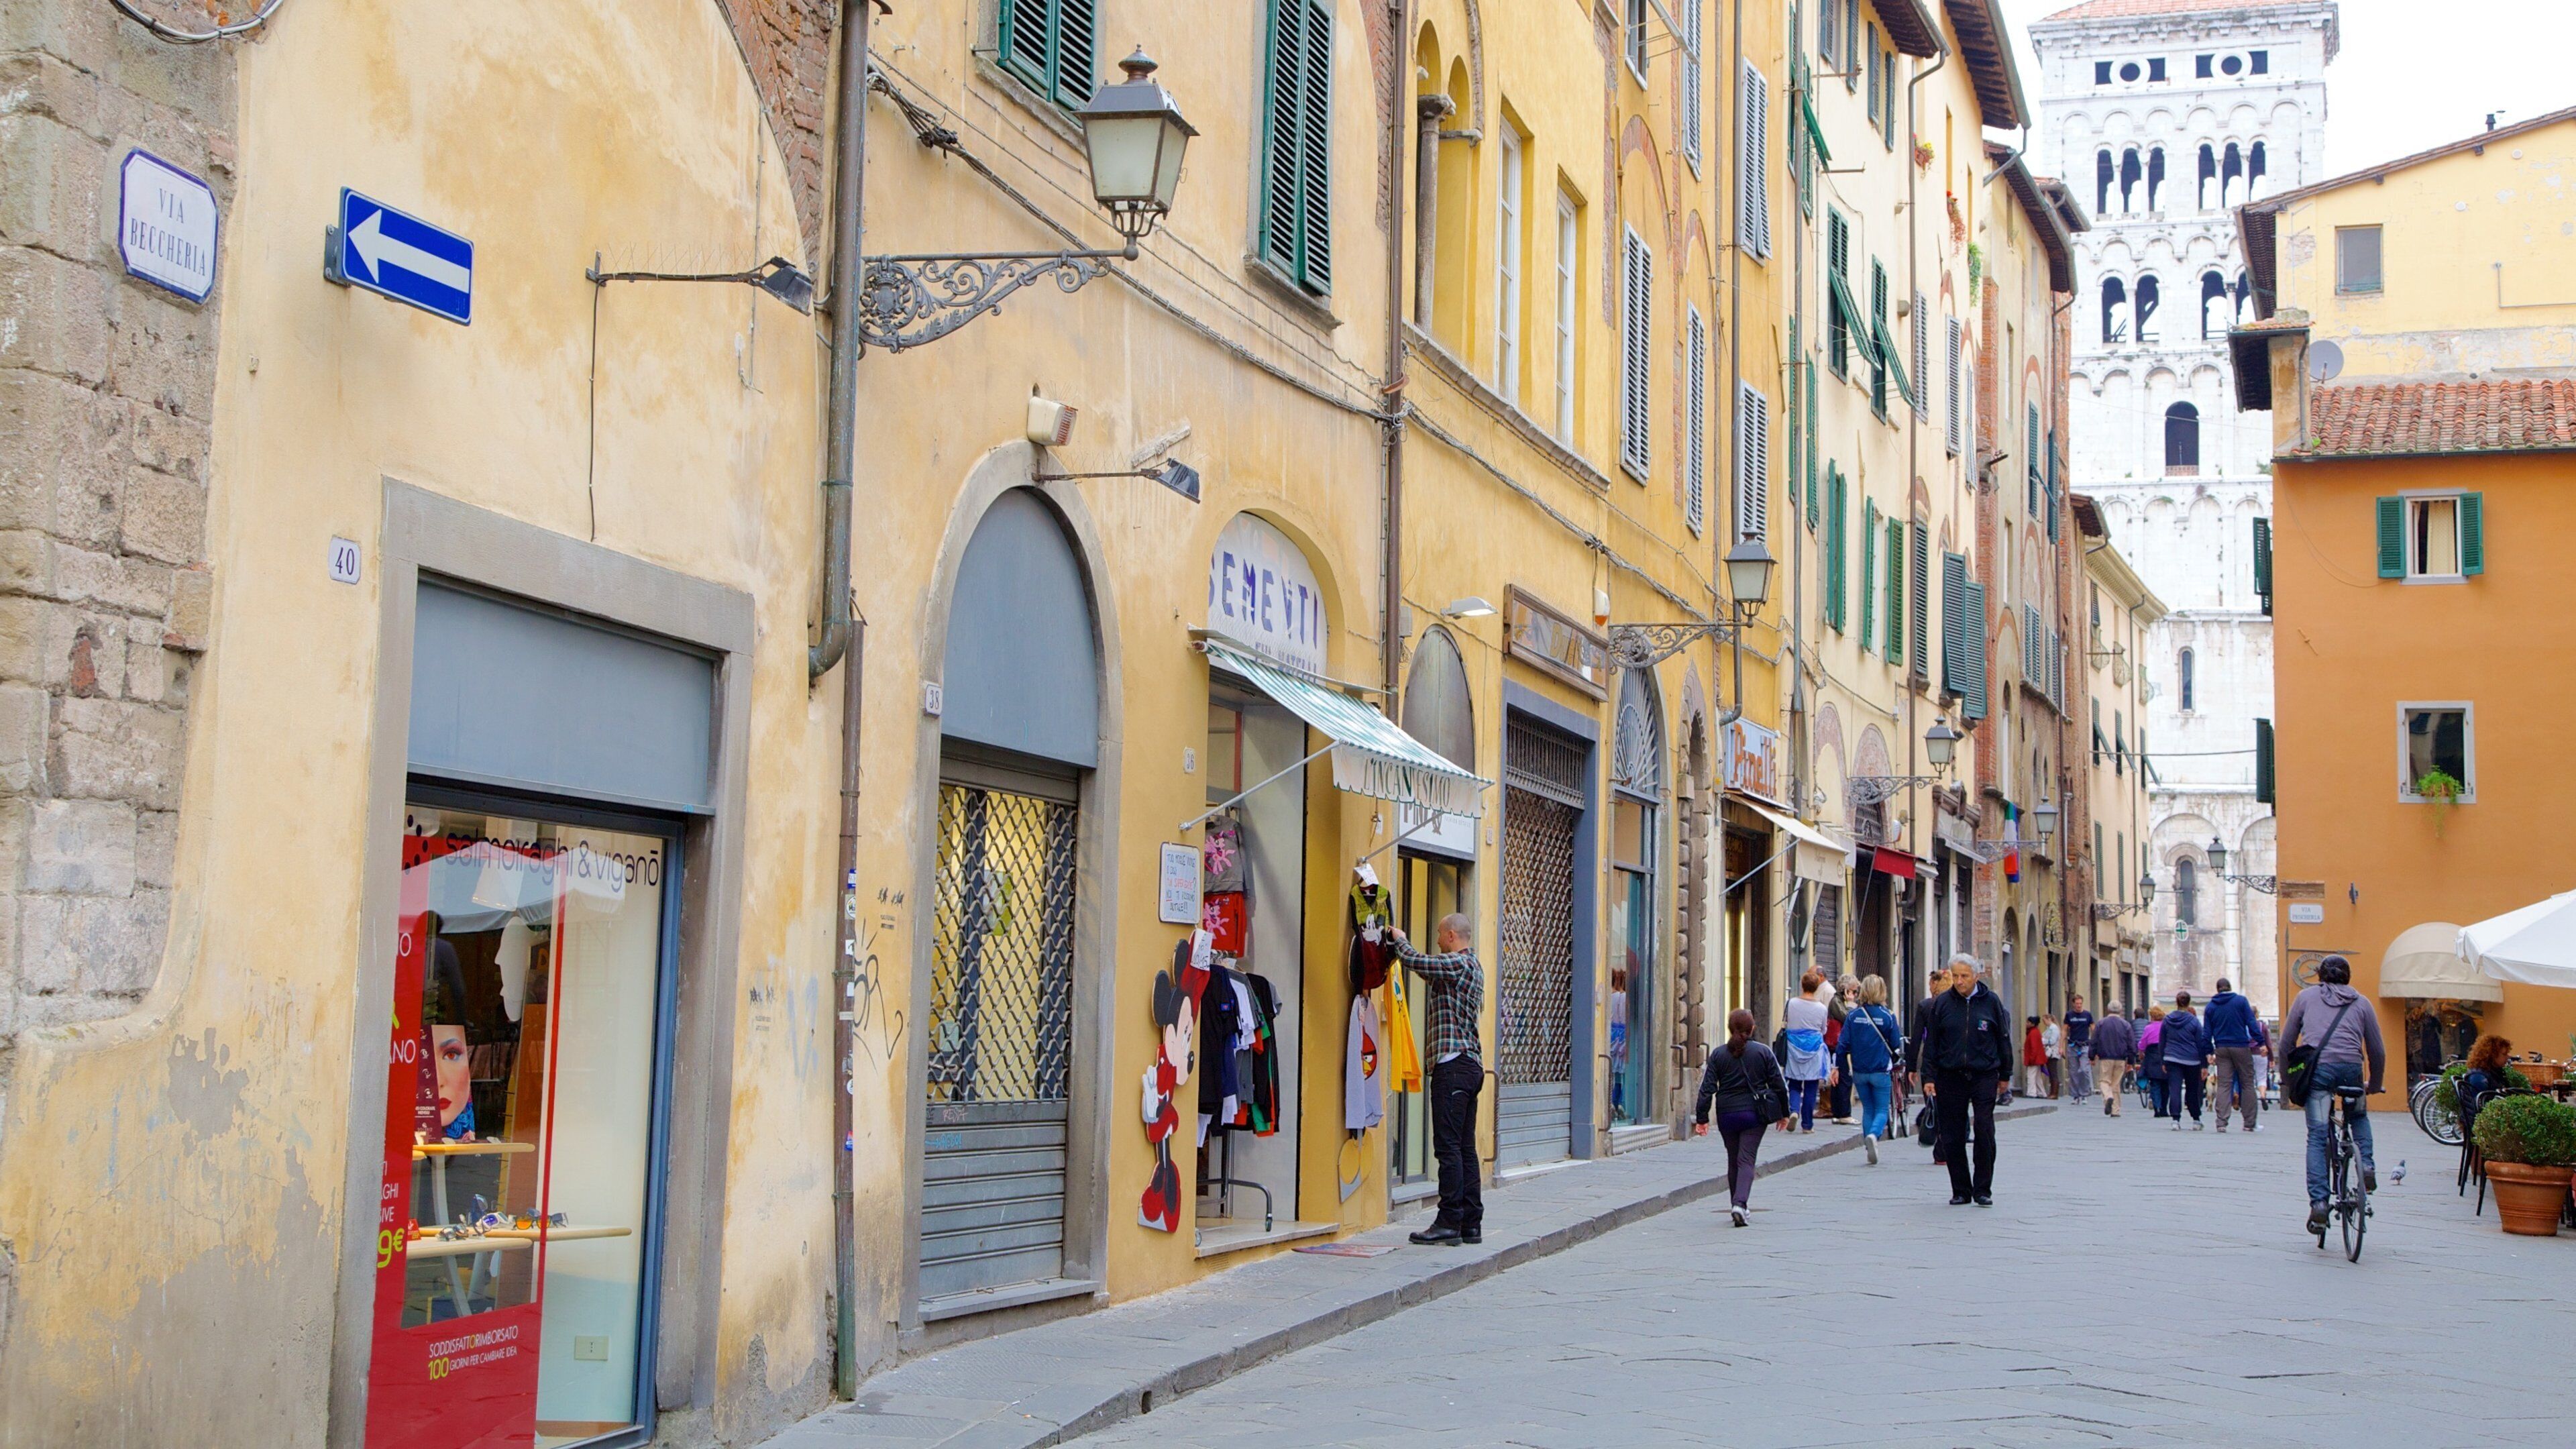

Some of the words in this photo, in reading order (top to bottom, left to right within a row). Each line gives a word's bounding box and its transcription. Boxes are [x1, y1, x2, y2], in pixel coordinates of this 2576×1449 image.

[159, 188, 184, 223] VIA
[130, 217, 205, 276] BECCHERIA
[335, 547, 356, 576] 40
[929, 690, 939, 710] 38
[1187, 753, 1194, 769] 36
[1364, 757, 1450, 807] L'INCANTESIMO
[445, 827, 573, 885] salmoiraghi
[578, 839, 591, 878] &
[428, 1357, 449, 1381] 100
[449, 1356, 469, 1371] GIORNI
[470, 1354, 480, 1366] PER
[506, 1346, 517, 1358] IDEA
